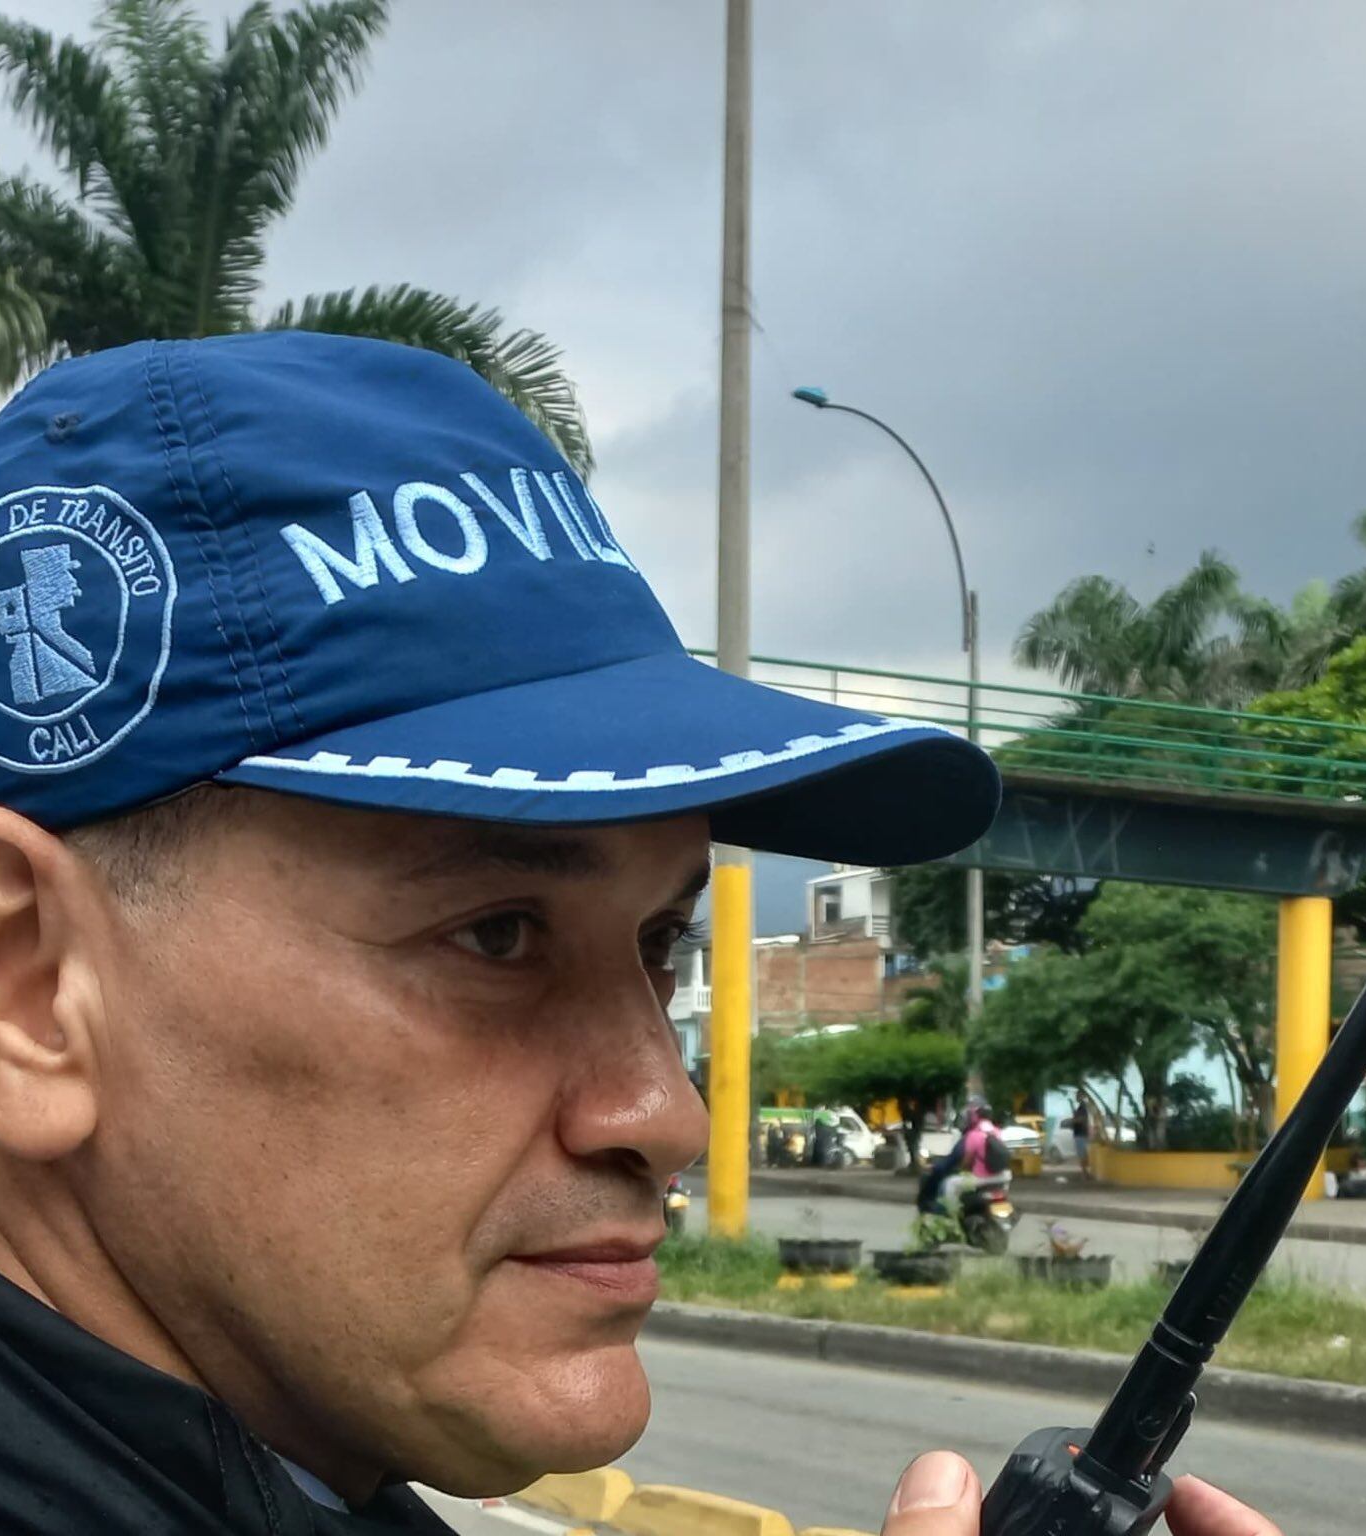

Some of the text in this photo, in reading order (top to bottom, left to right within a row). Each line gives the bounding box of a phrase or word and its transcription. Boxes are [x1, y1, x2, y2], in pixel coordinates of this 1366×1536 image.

[9, 499, 47, 532] DE
[56, 498, 162, 597] TRANSITO
[279, 467, 638, 605] MOVIL
[28, 714, 101, 761] CALI
